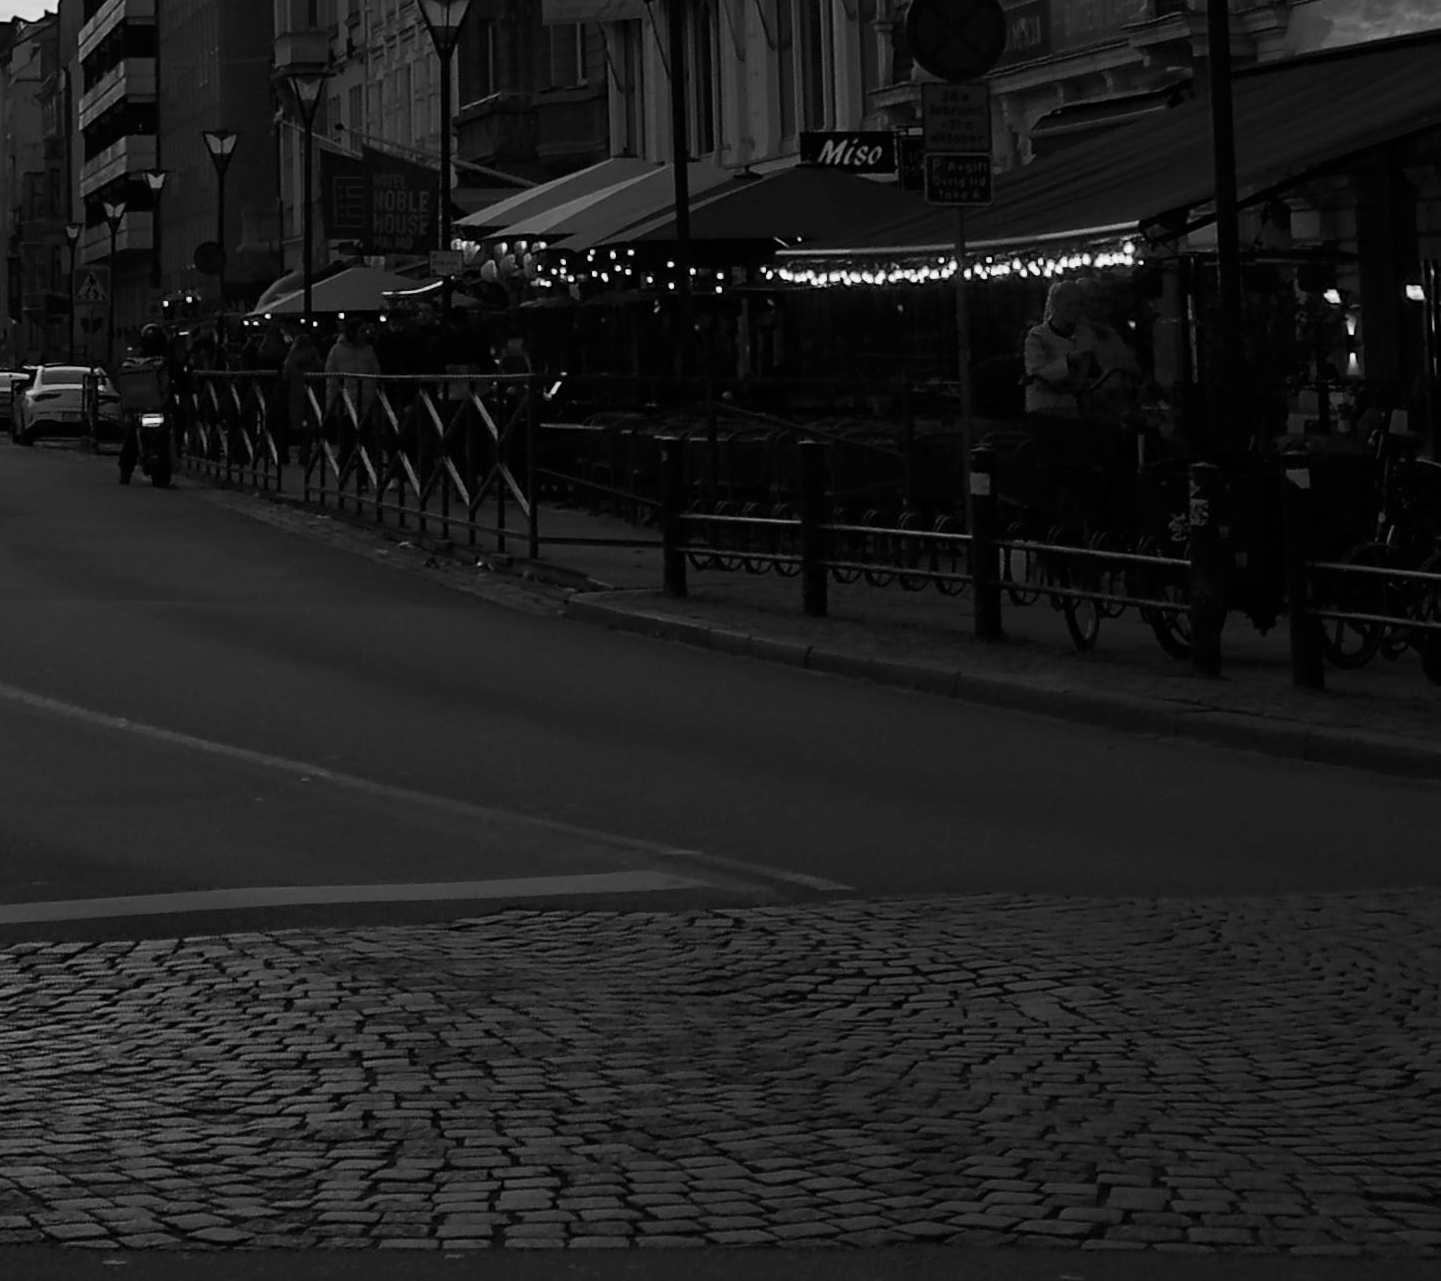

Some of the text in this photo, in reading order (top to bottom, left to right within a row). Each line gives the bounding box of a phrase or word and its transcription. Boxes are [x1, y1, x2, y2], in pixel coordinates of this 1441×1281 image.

[817, 138, 883, 166] Miso
[373, 189, 430, 213] NOBLE
[373, 212, 430, 236] HOUSE
